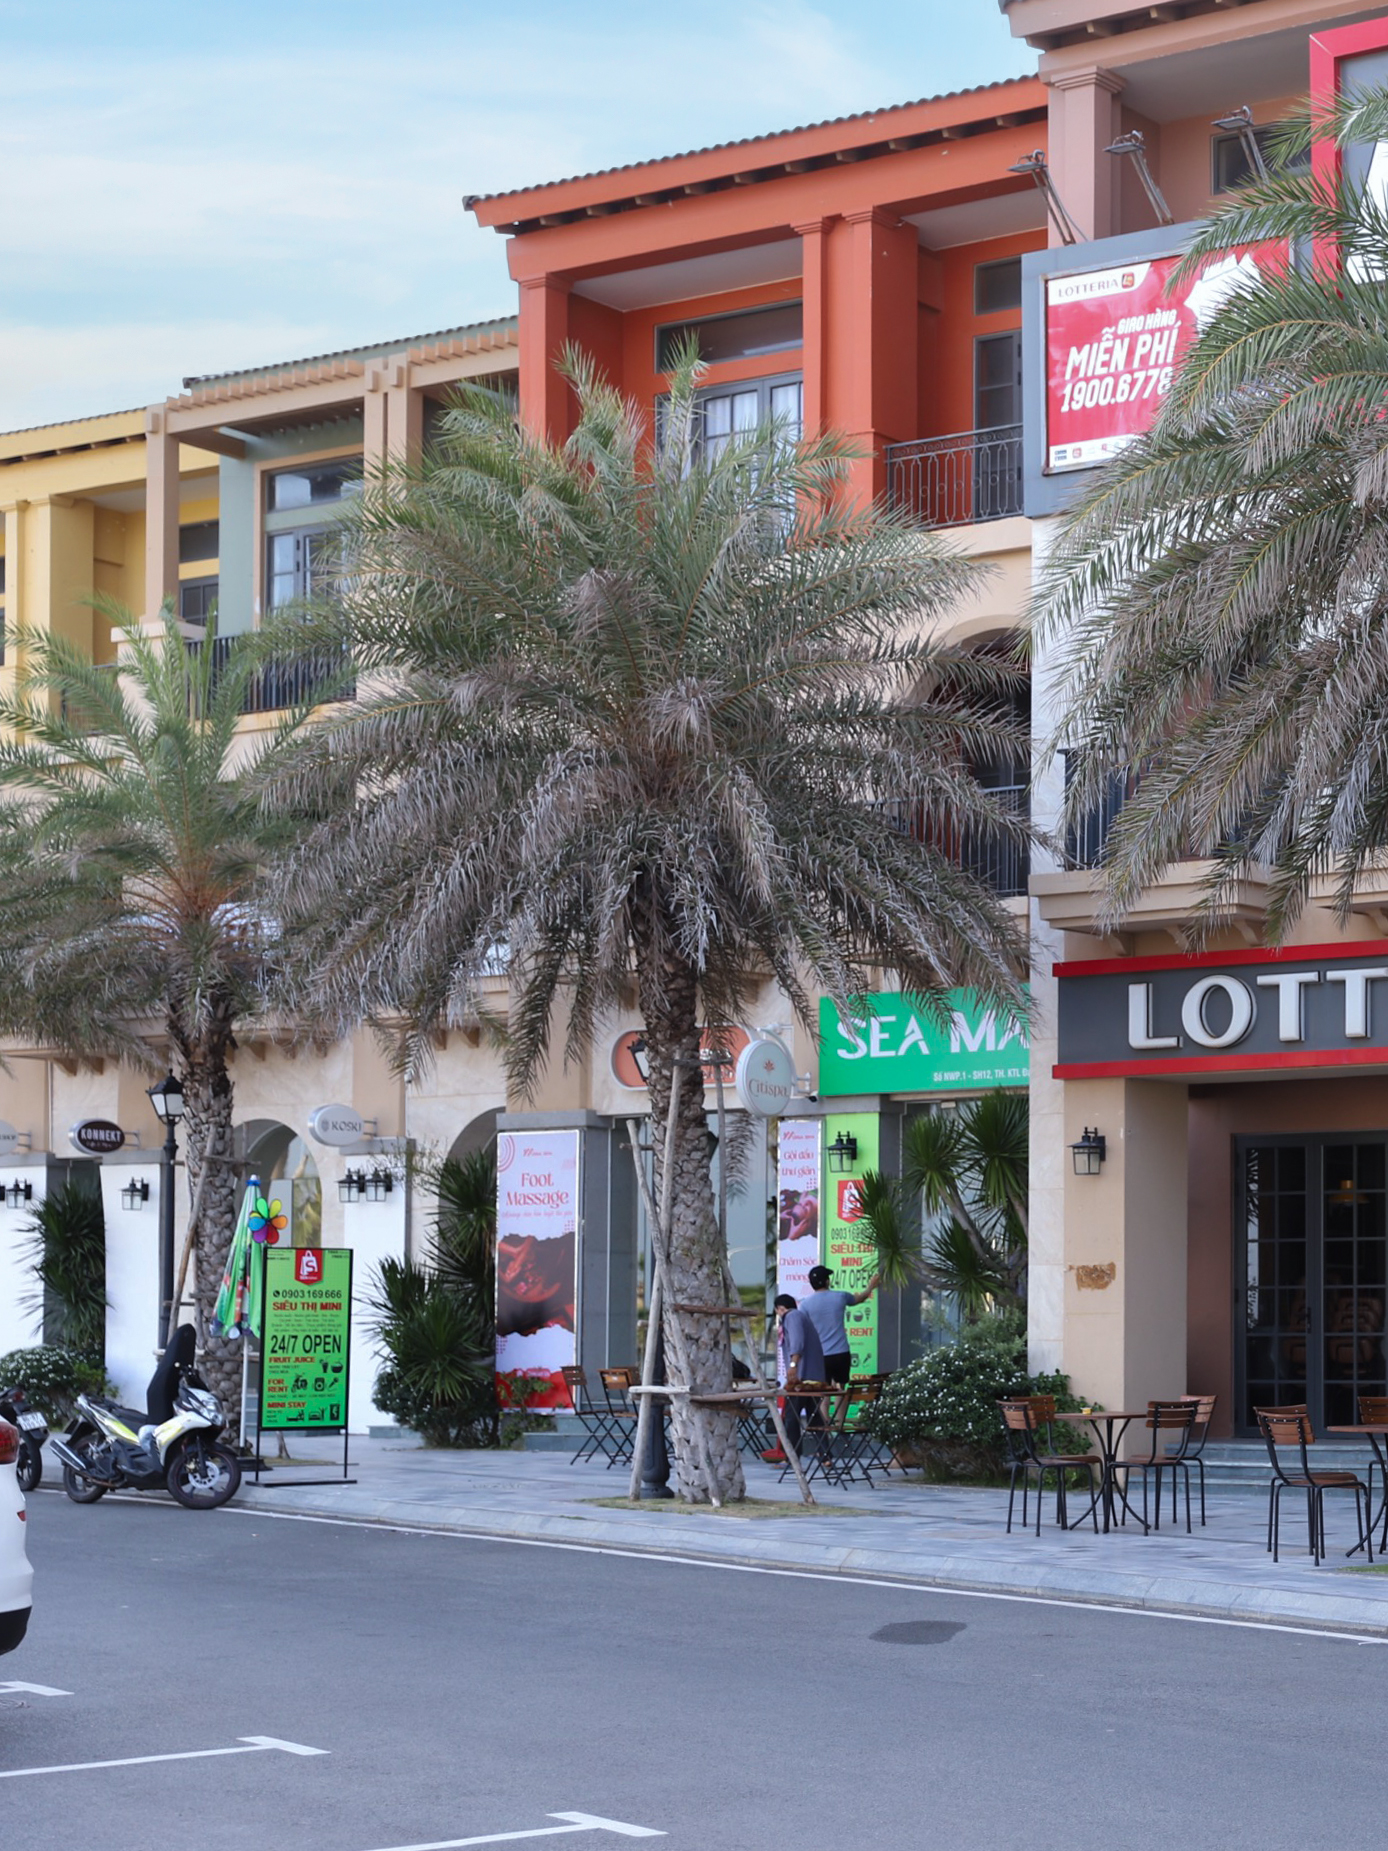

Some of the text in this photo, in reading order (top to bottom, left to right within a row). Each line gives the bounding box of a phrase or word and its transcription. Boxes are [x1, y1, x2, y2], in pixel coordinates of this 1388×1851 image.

[1058, 279, 1119, 298] LOTTERIA
[1117, 308, 1178, 334] GIAO HÀNG
[1065, 320, 1182, 380] MIỄN PHÍ
[837, 1014, 930, 1060] SEA
[81, 1128, 121, 1142] KONNEKT
[331, 1120, 362, 1132] KOSKI
[521, 1171, 554, 1187] Foot
[506, 1189, 569, 1209] Massage
[281, 1290, 342, 1299] 0903 169 666
[272, 1300, 342, 1313] SIÊU THỊ MINI
[270, 1334, 342, 1354] 24/7 OPEN
